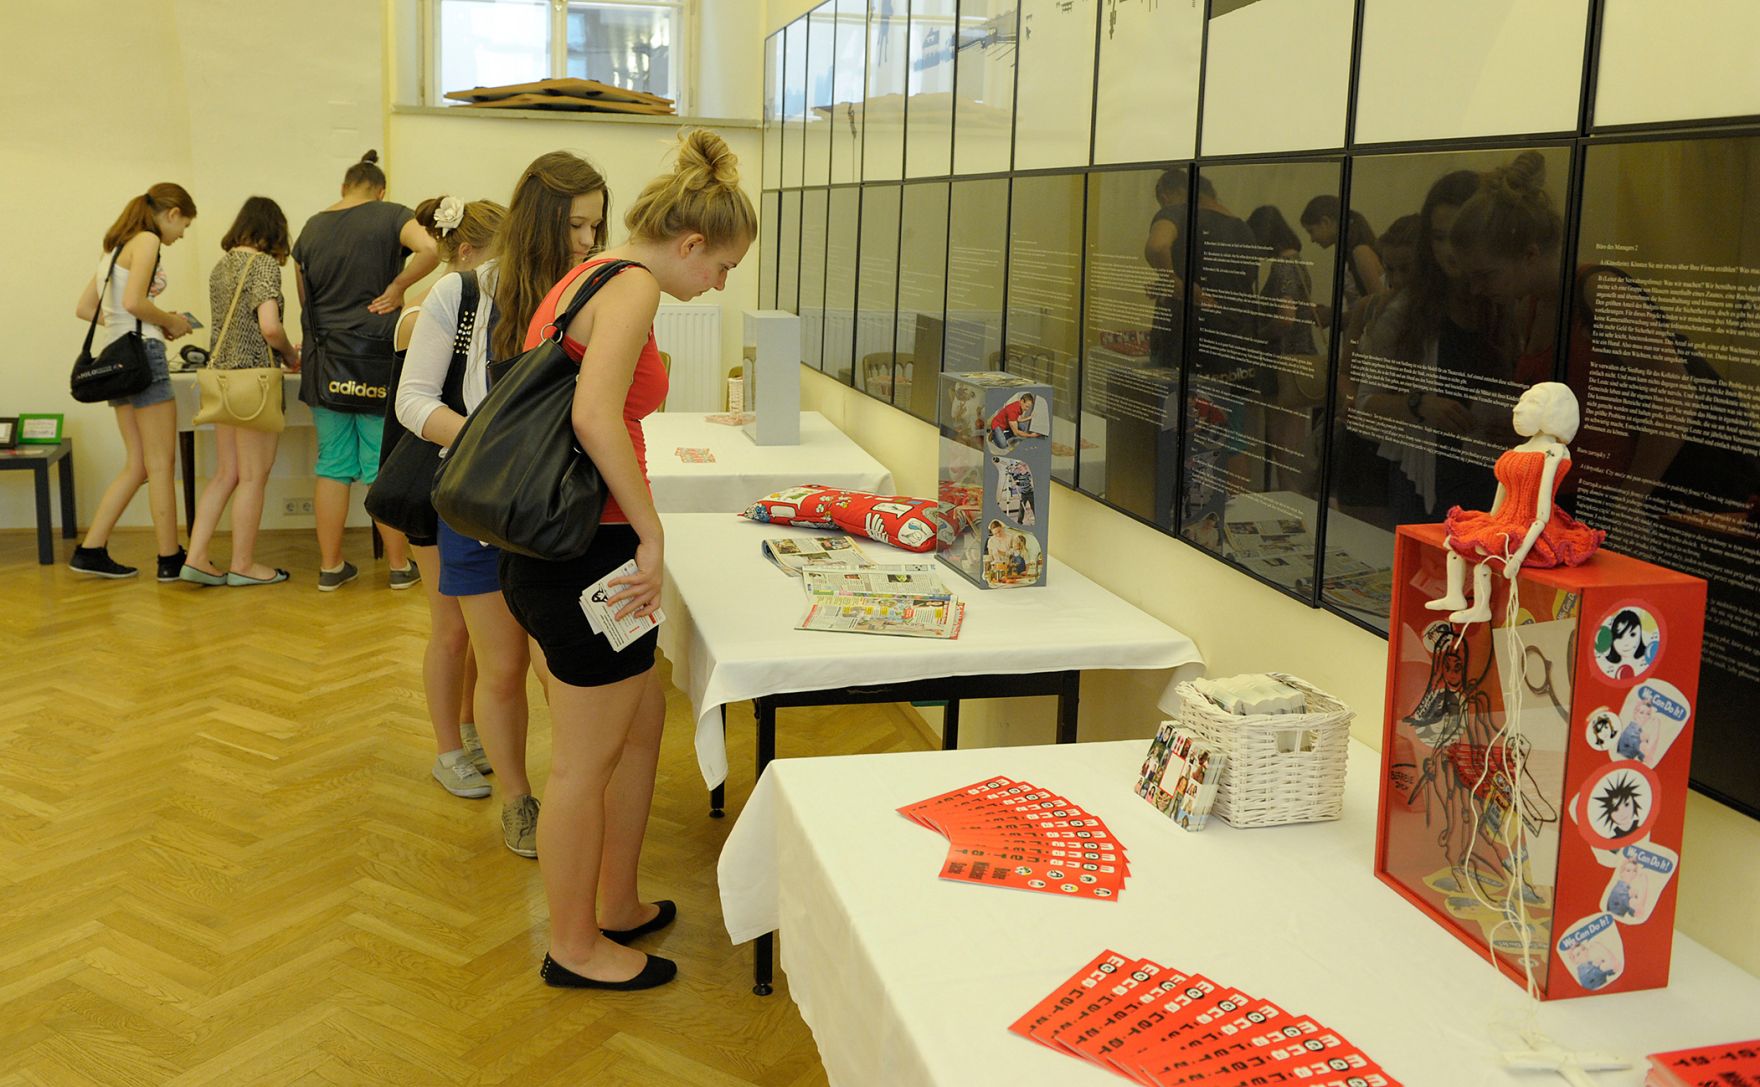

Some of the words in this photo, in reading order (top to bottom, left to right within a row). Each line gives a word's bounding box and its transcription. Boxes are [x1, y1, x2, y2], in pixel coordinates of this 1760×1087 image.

[328, 380, 387, 398] adidas
[1642, 687, 1652, 698] We
[1652, 696, 1665, 707] Can
[1664, 702, 1674, 712] Do
[1674, 708, 1684, 718] It!
[1628, 846, 1638, 858] We
[1638, 852, 1650, 862] Can
[1650, 856, 1660, 866] Do
[1660, 860, 1670, 871] It!
[1563, 935, 1576, 948] We
[1575, 929, 1590, 941] Can
[1590, 922, 1600, 932] Do
[1600, 916, 1610, 927] It!
